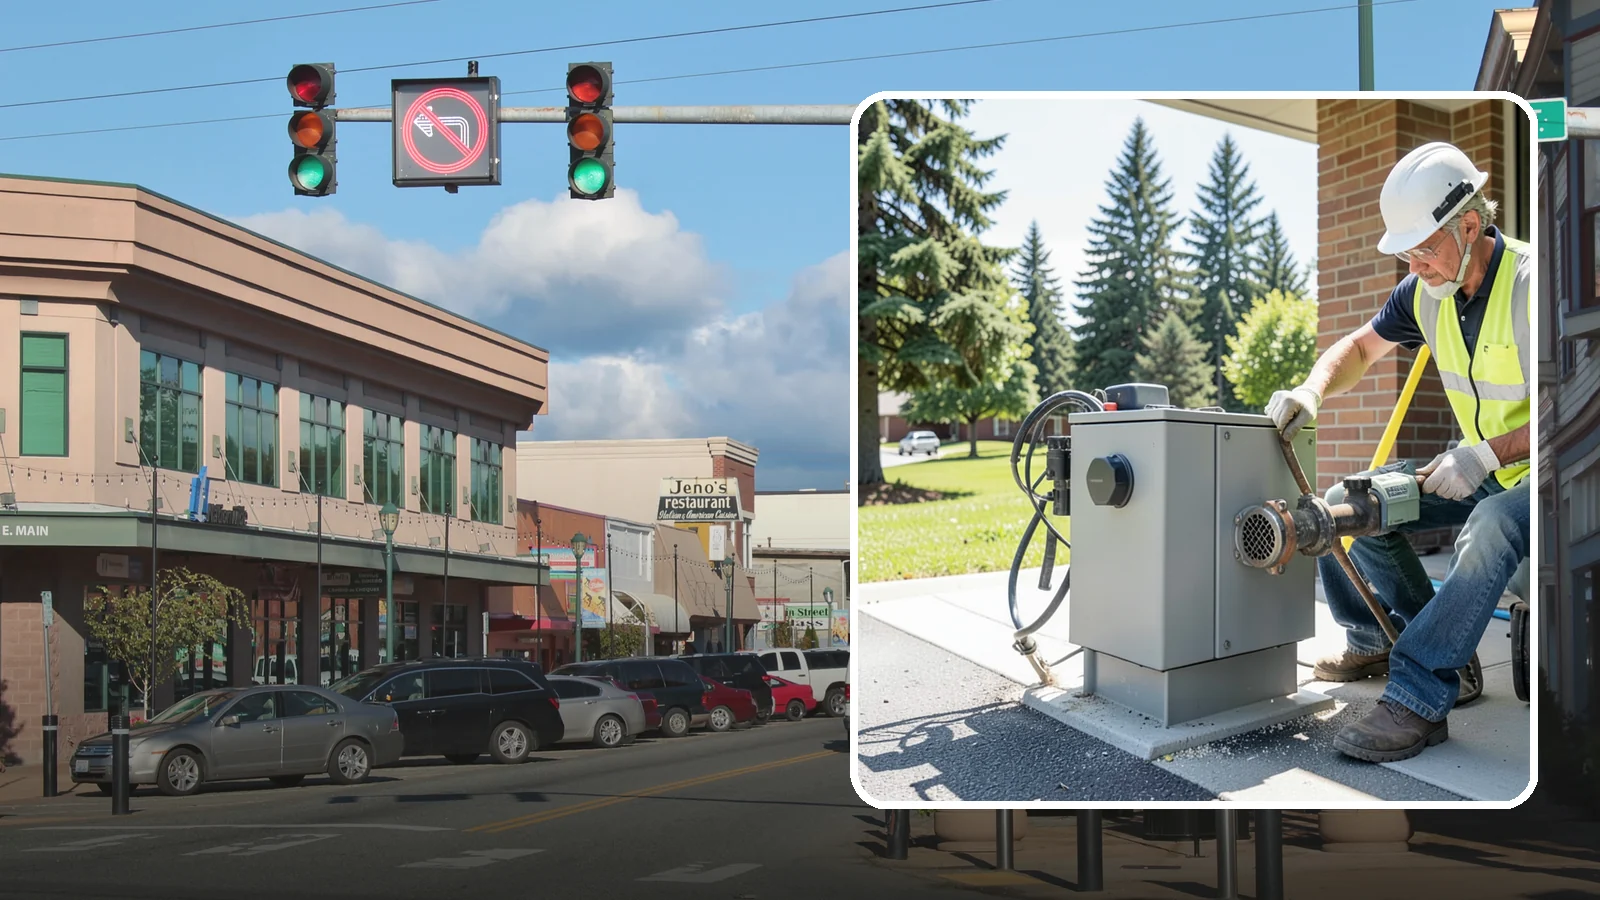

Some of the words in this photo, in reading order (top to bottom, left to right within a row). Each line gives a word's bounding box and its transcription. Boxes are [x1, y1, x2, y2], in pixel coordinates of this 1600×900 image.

[670, 480, 728, 494] Jeno's
[665, 496, 731, 509] restaurant
[659, 510, 682, 520] Italian
[686, 510, 715, 519] American
[715, 510, 738, 520] Cuisine
[2, 525, 13, 536] E.
[15, 525, 49, 536] MAIN
[797, 607, 829, 617] Street
[790, 619, 824, 627] lass
